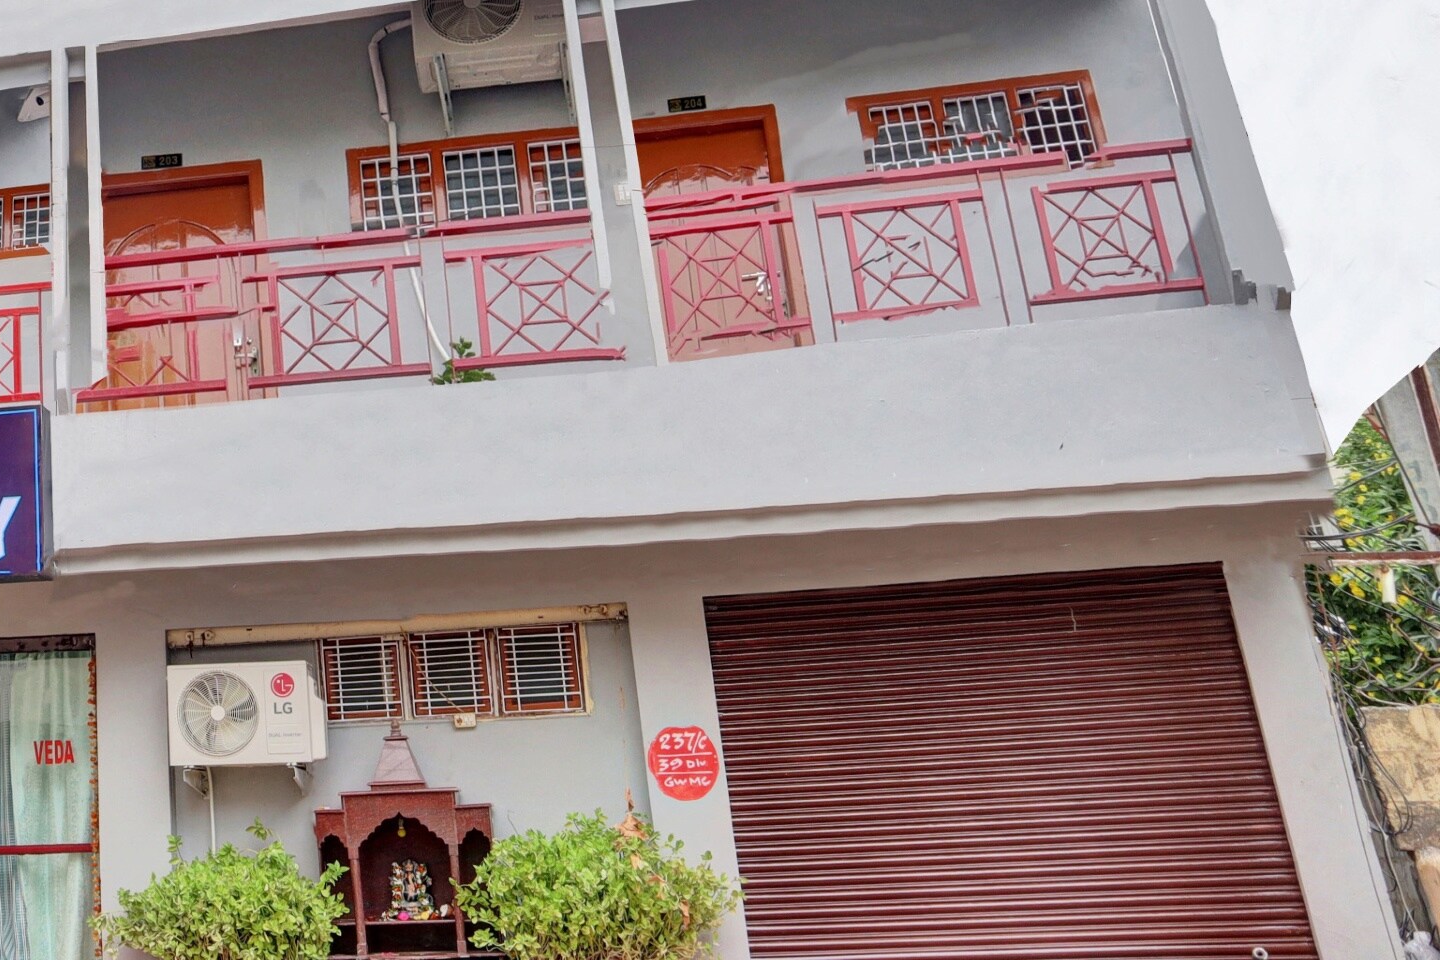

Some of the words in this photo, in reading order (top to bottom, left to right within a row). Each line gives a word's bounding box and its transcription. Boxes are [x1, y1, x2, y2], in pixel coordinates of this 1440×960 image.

[683, 98, 703, 109] 204
[159, 156, 178, 166] 203
[273, 701, 293, 715] LG
[659, 731, 708, 754] 237/C
[33, 740, 75, 765] VEDA
[658, 758, 683, 772] 39
